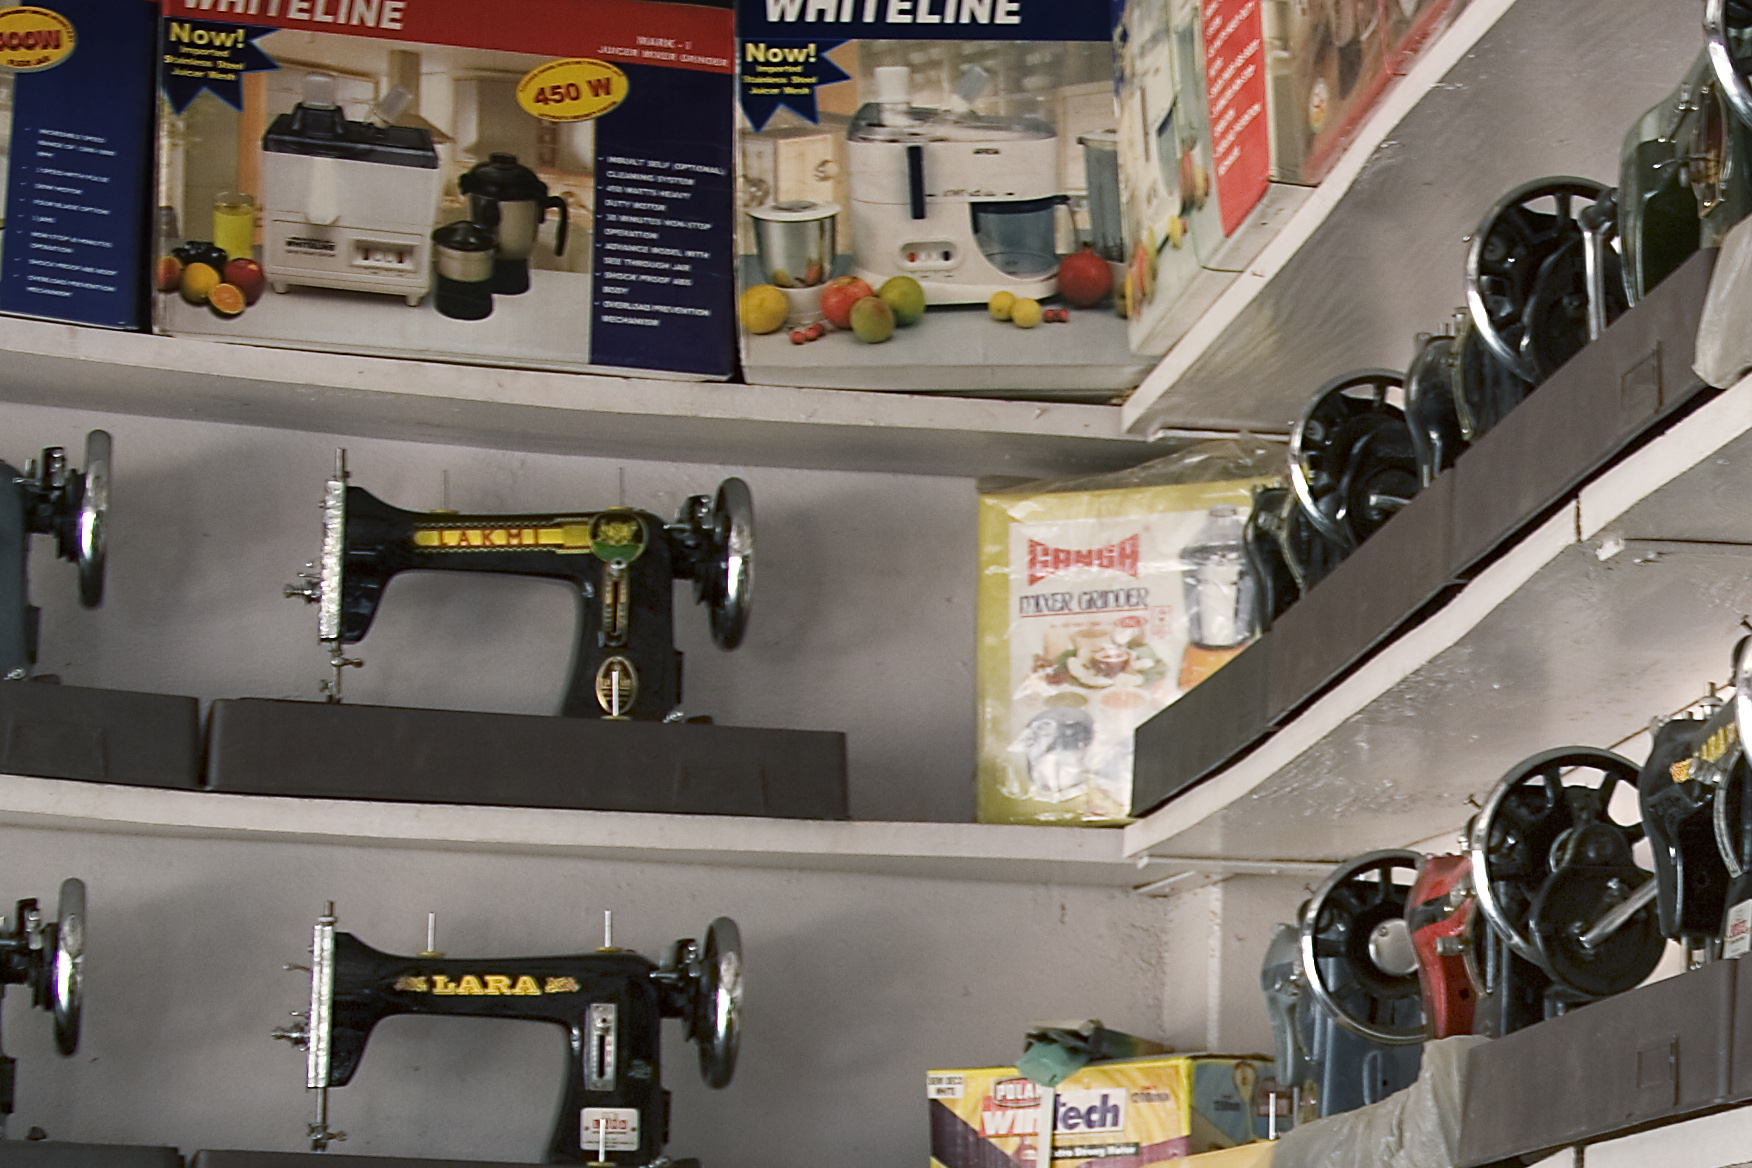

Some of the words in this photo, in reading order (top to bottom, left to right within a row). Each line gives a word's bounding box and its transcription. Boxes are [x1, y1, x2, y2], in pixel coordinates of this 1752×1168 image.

[765, 0, 1021, 24] WHITELINE
[0, 30, 61, 51] 00W
[169, 22, 246, 48] Now!
[598, 45, 638, 57] JUICER
[745, 43, 817, 63] Now!
[533, 82, 581, 106] 450
[587, 77, 612, 98] W
[1019, 592, 1074, 614] MIXER
[1078, 587, 1149, 611] GRINDER
[432, 975, 542, 996] LARA
[1054, 1147, 1073, 1158] xtra
